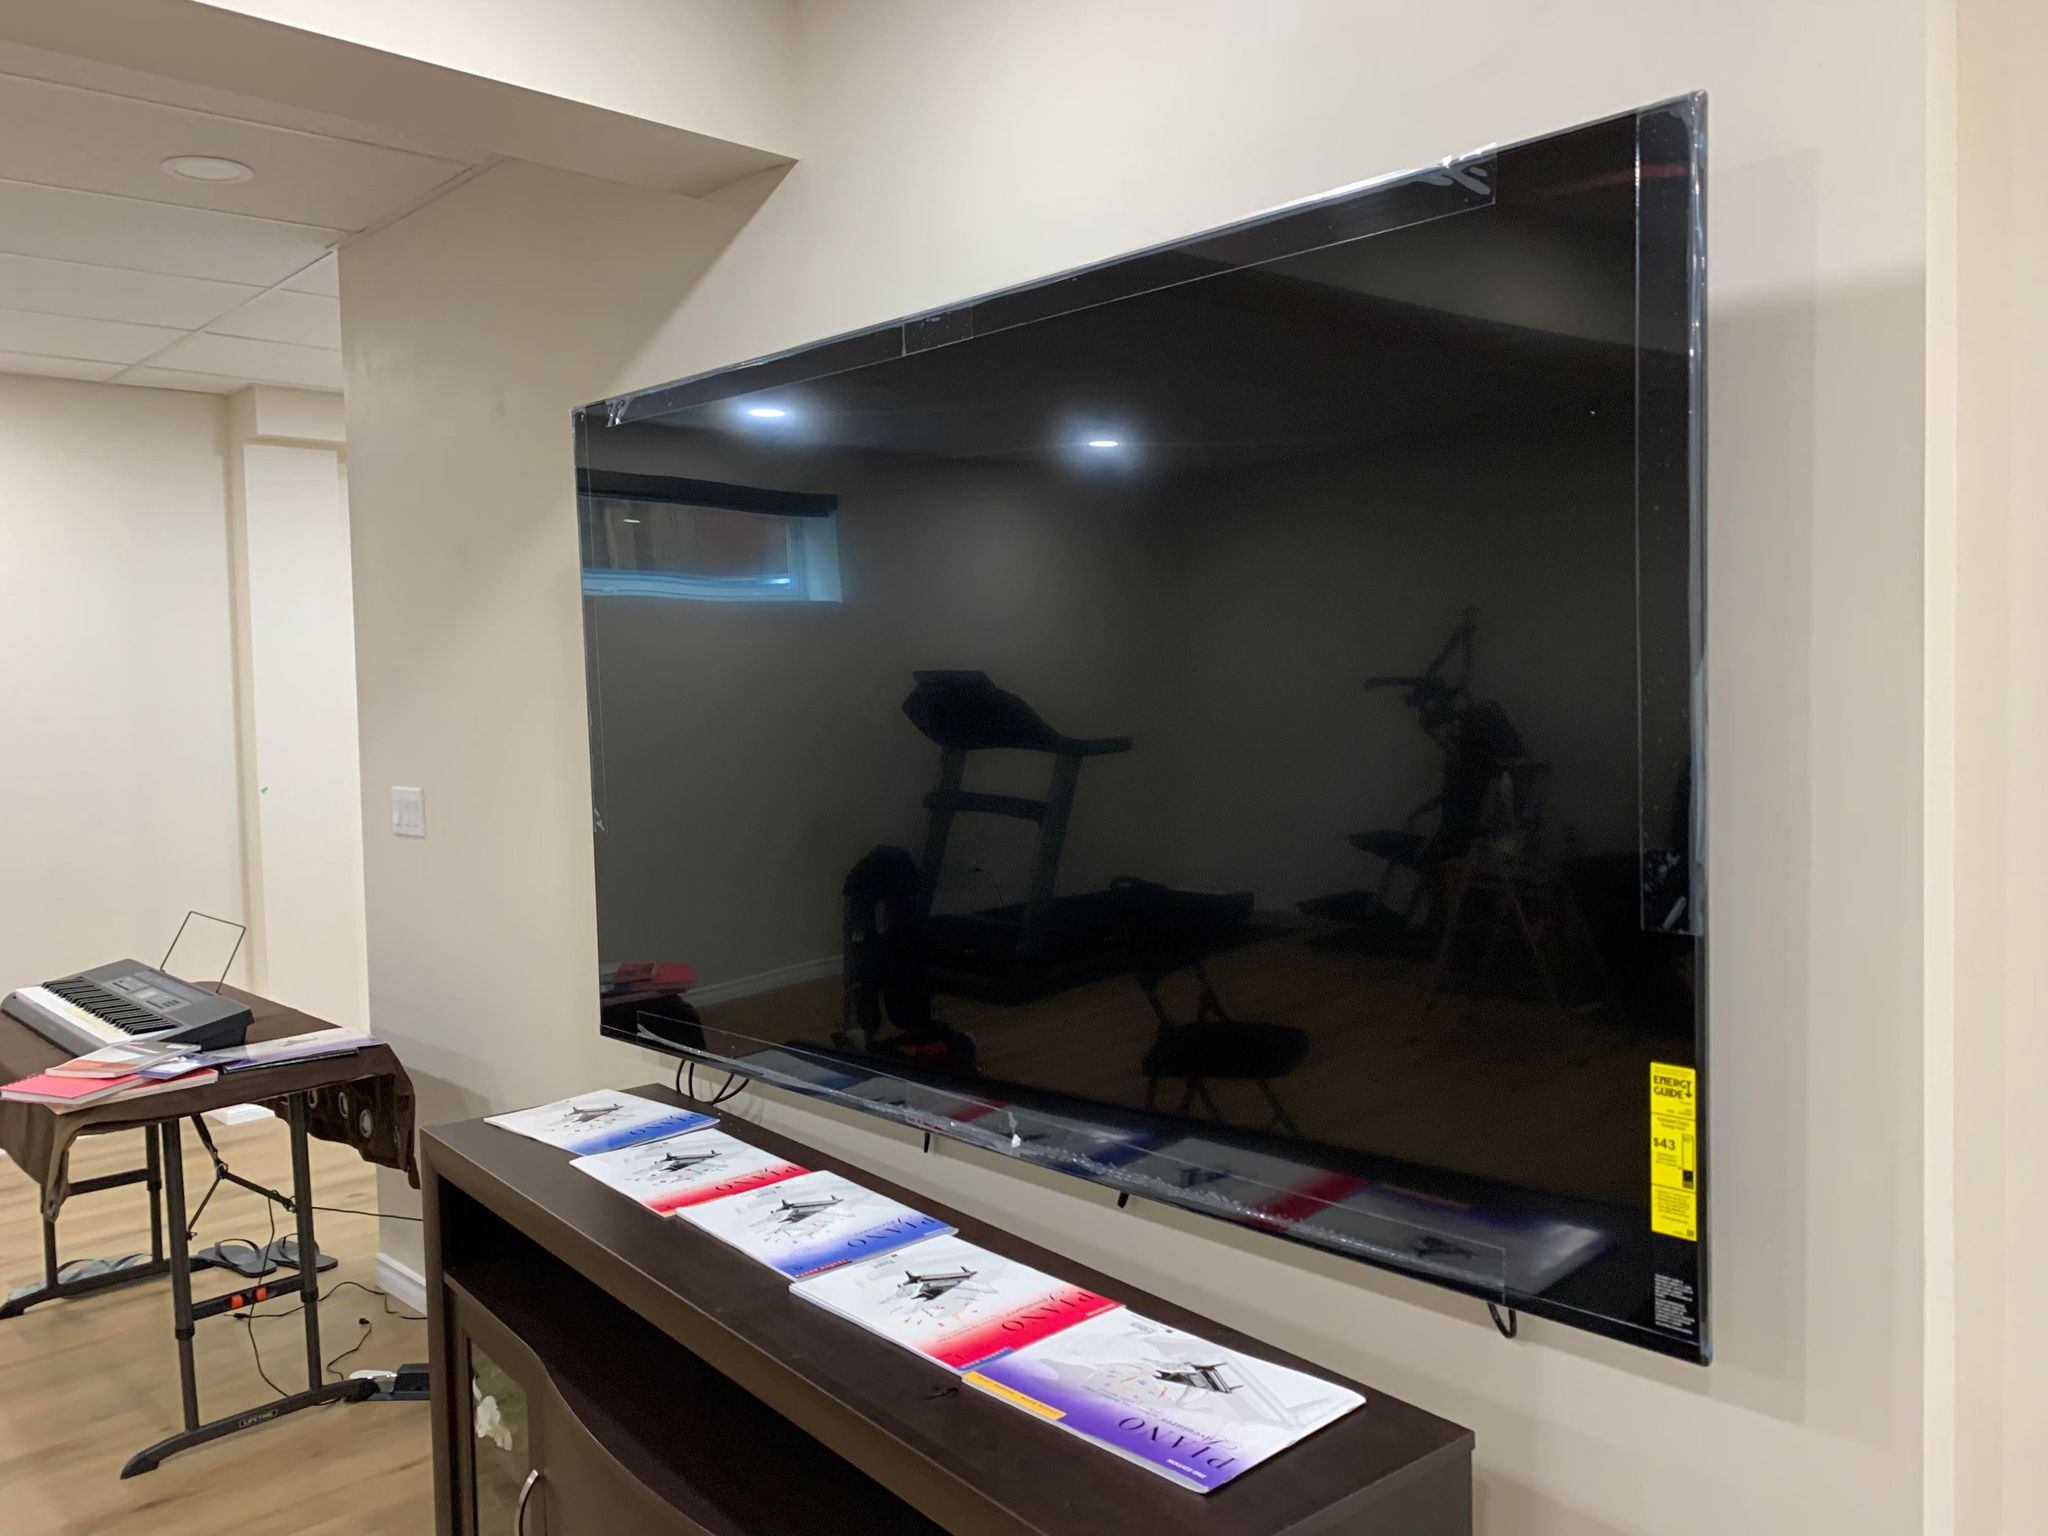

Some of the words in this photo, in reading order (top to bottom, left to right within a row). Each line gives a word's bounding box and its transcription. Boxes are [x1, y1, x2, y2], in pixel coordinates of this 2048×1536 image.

[1653, 1086, 1684, 1100] GUIDE
[1653, 1137, 1676, 1151] $43
[714, 1165, 798, 1191] PIANO
[846, 1216, 936, 1248] PIANO
[1000, 1291, 1096, 1332] PIANO
[1117, 1416, 1237, 1470] PIANO
